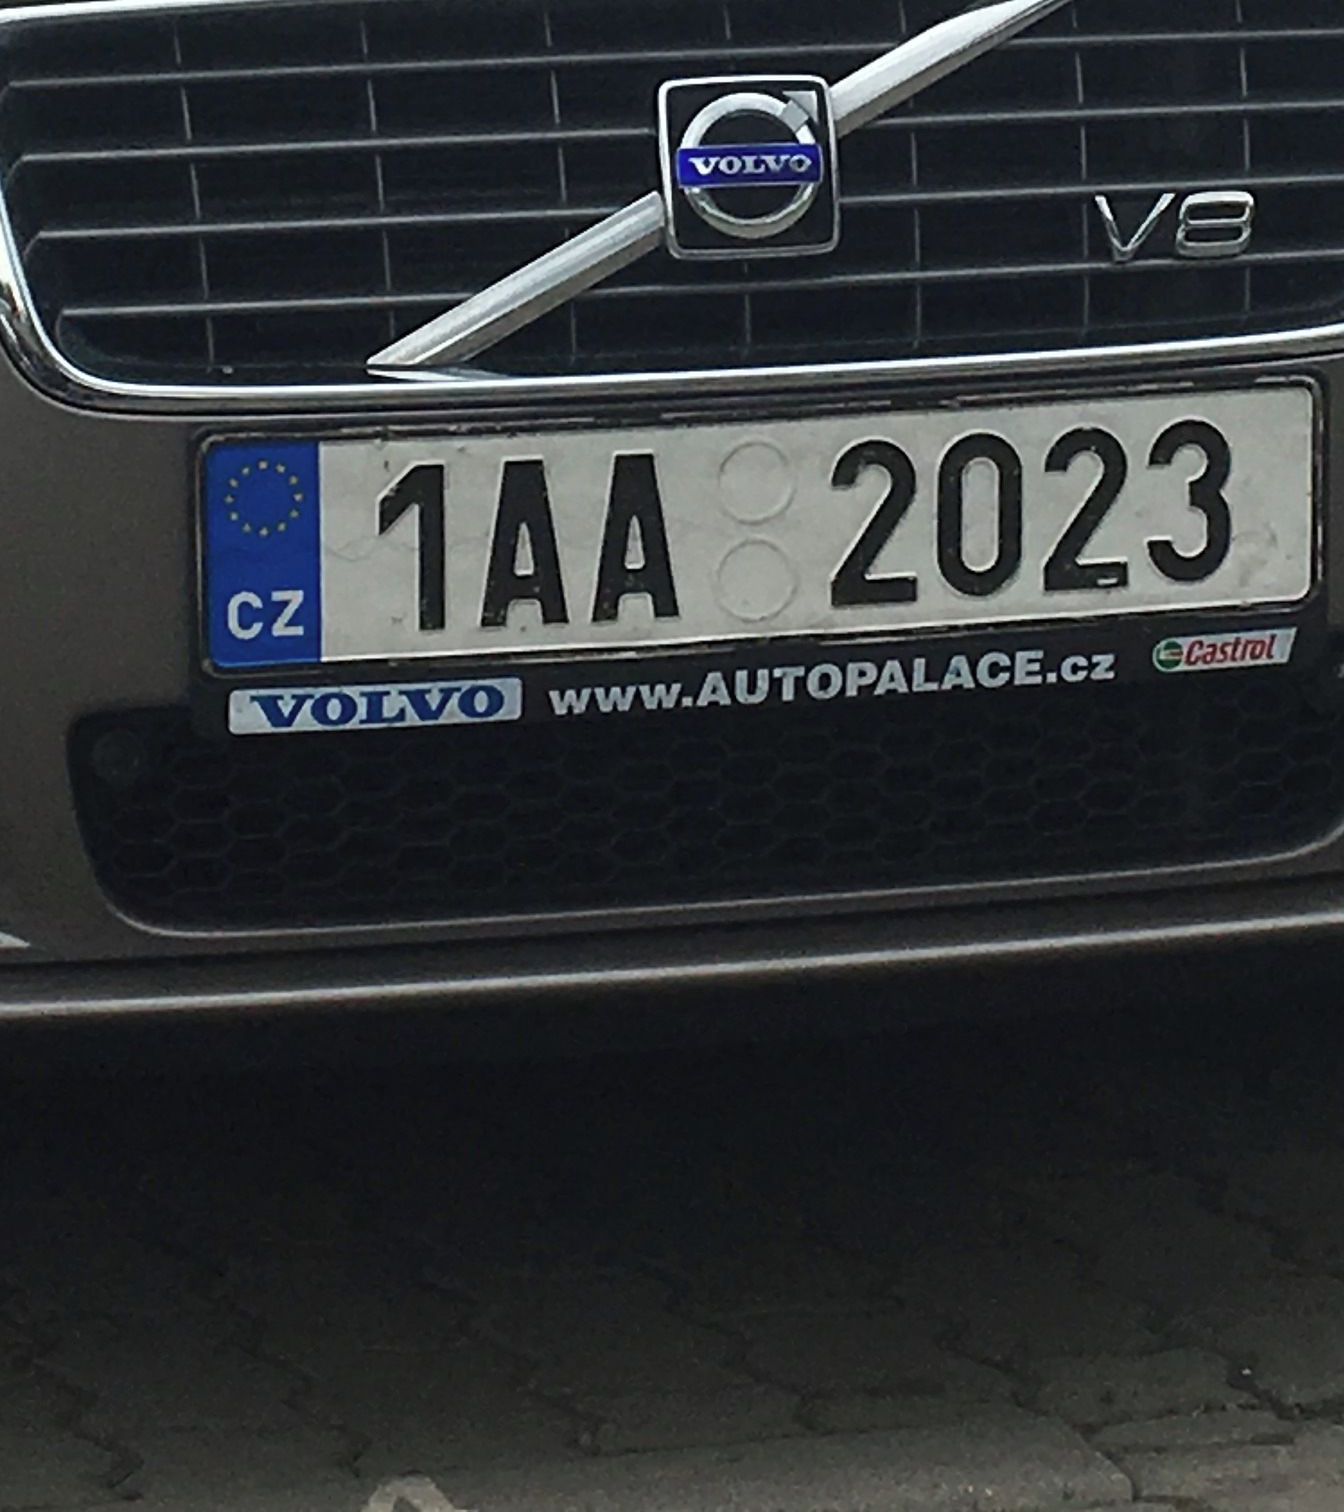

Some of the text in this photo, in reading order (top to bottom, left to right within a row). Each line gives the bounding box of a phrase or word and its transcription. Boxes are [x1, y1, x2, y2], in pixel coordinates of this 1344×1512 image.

[687, 154, 813, 176] VOLVO
[1093, 190, 1255, 263] V8
[378, 418, 1231, 631] 1AA 2023
[226, 589, 305, 640] CZ
[1184, 633, 1278, 666] Castrol
[249, 684, 505, 728] VOLVO
[548, 649, 1116, 716] www.AUTOPALACE.cz
